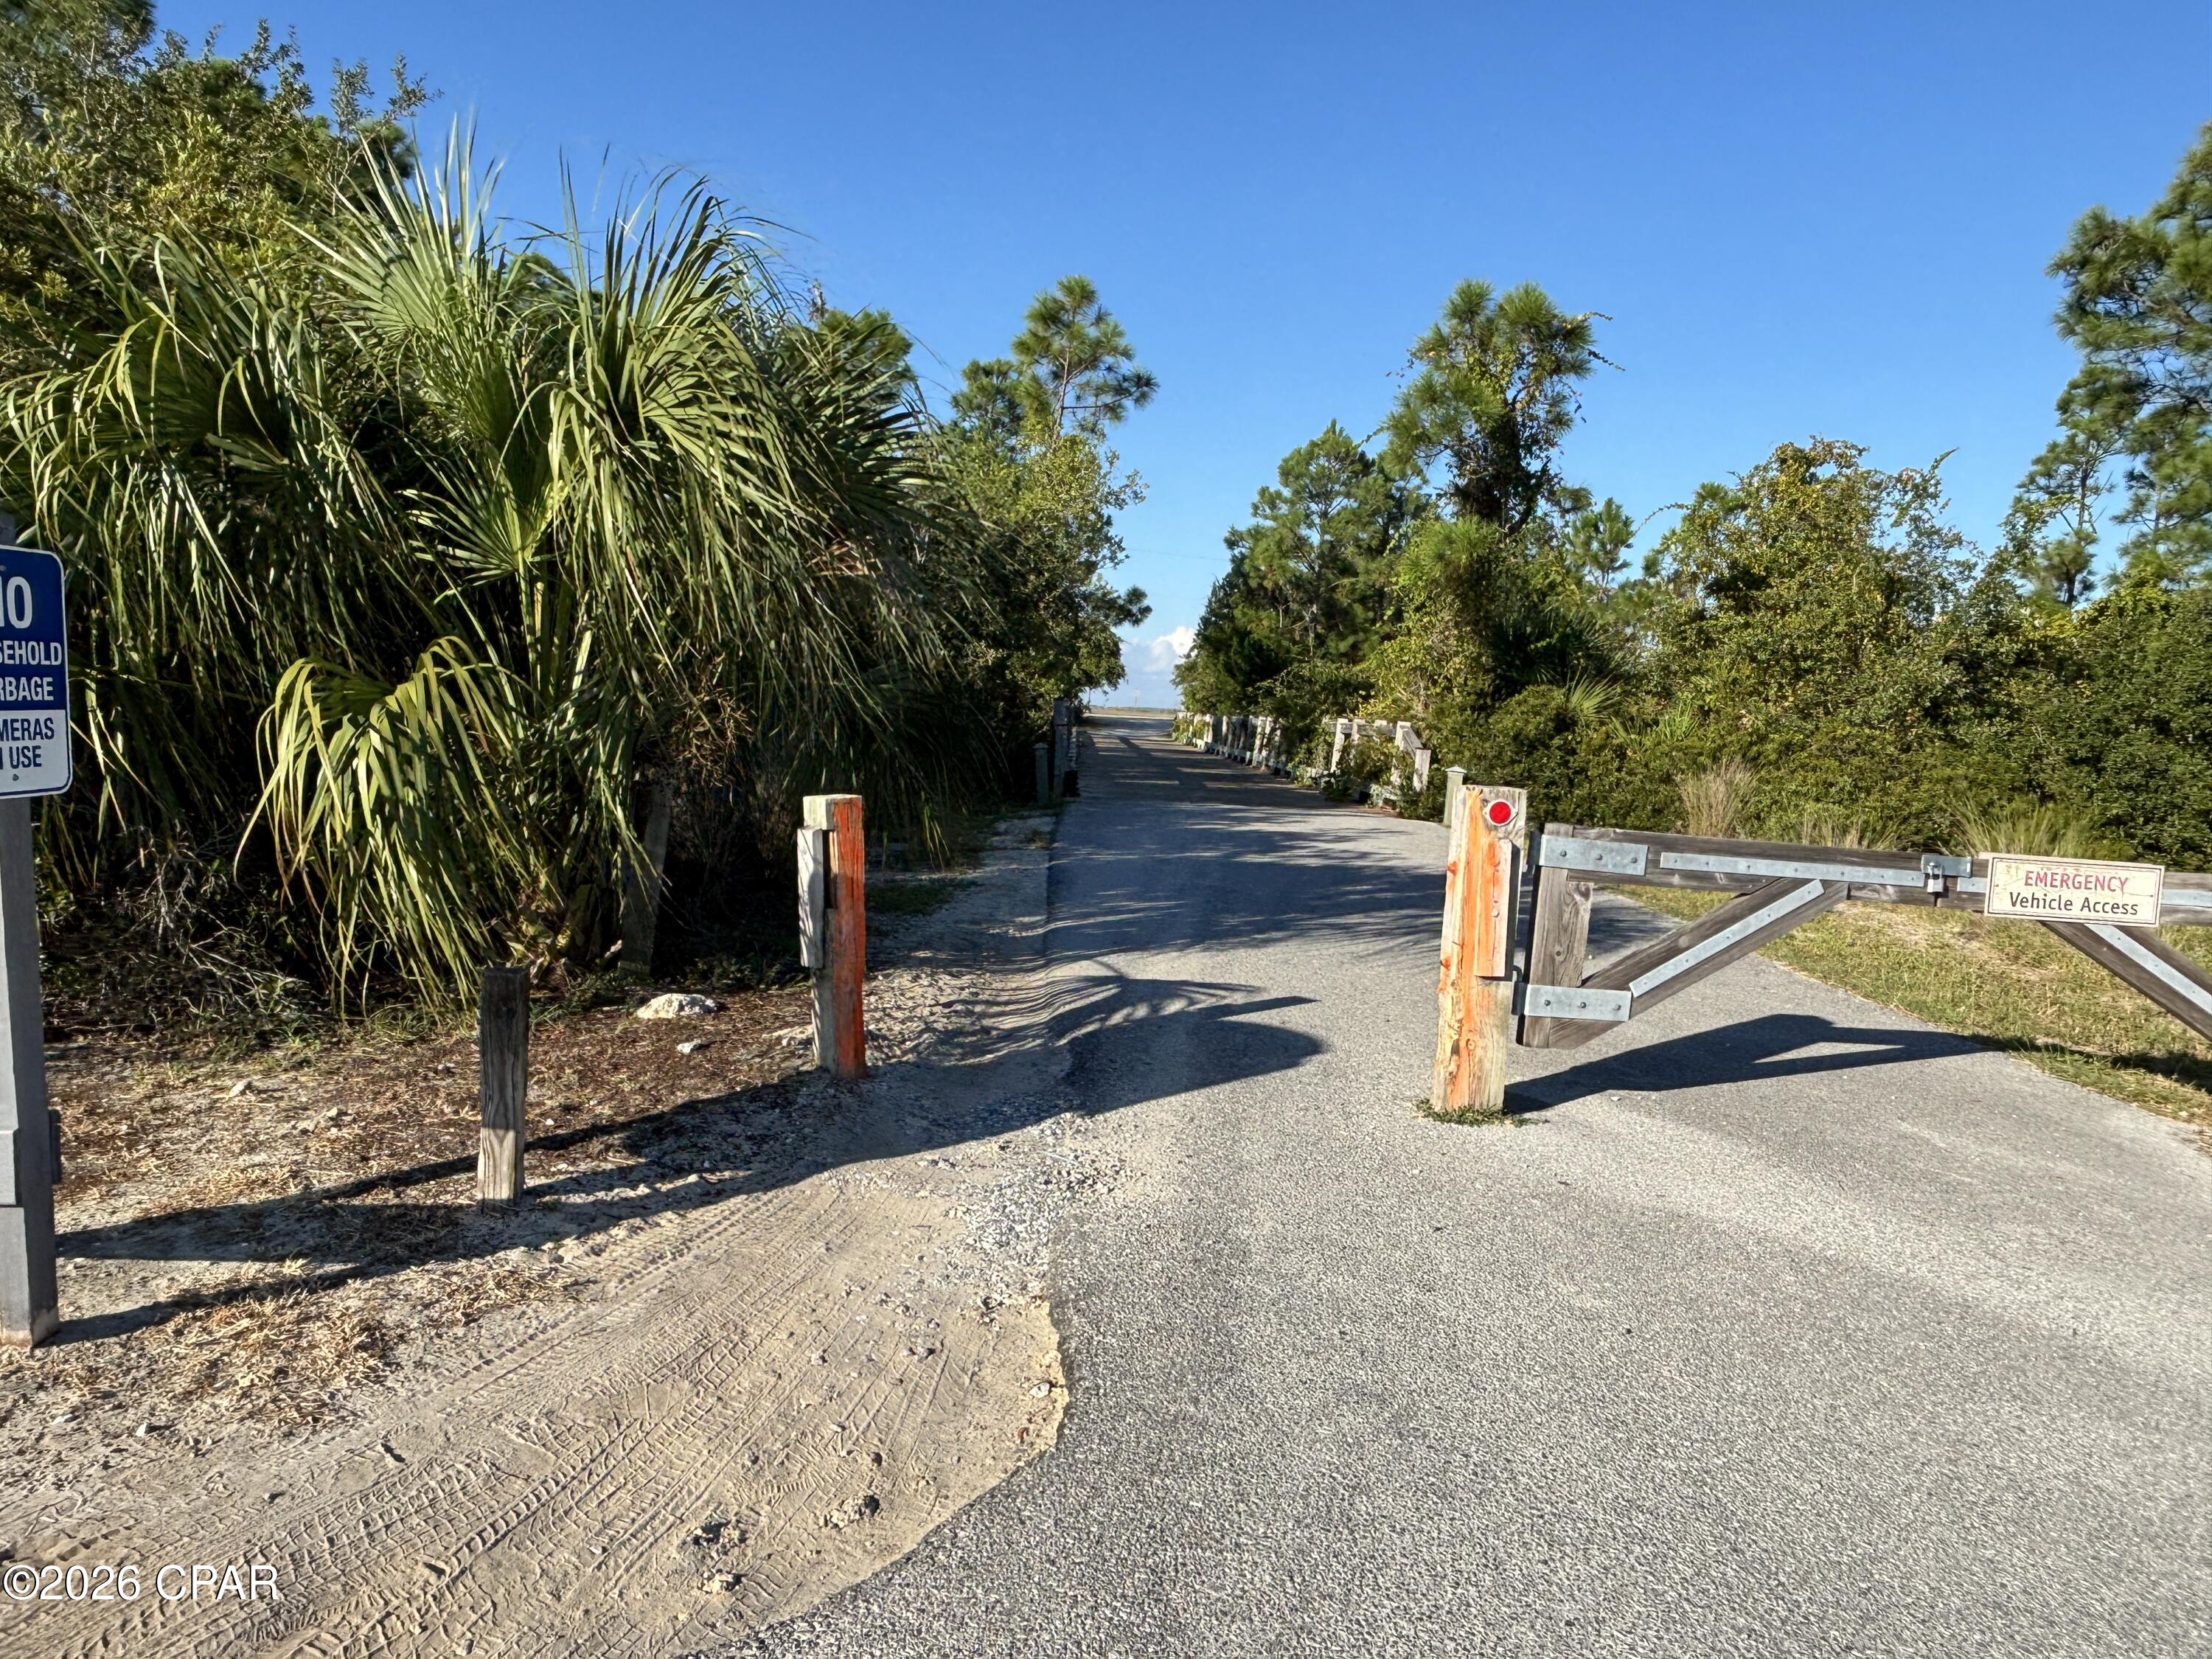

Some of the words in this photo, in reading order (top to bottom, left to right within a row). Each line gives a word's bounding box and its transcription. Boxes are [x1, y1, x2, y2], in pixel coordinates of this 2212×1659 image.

[0, 575, 32, 629] O
[0, 640, 63, 665] EHOLD
[9, 745, 42, 770] USE
[2024, 870, 2129, 893] EMERGENCY
[2009, 891, 2073, 911] Vehicle
[2080, 897, 2139, 916] Access
